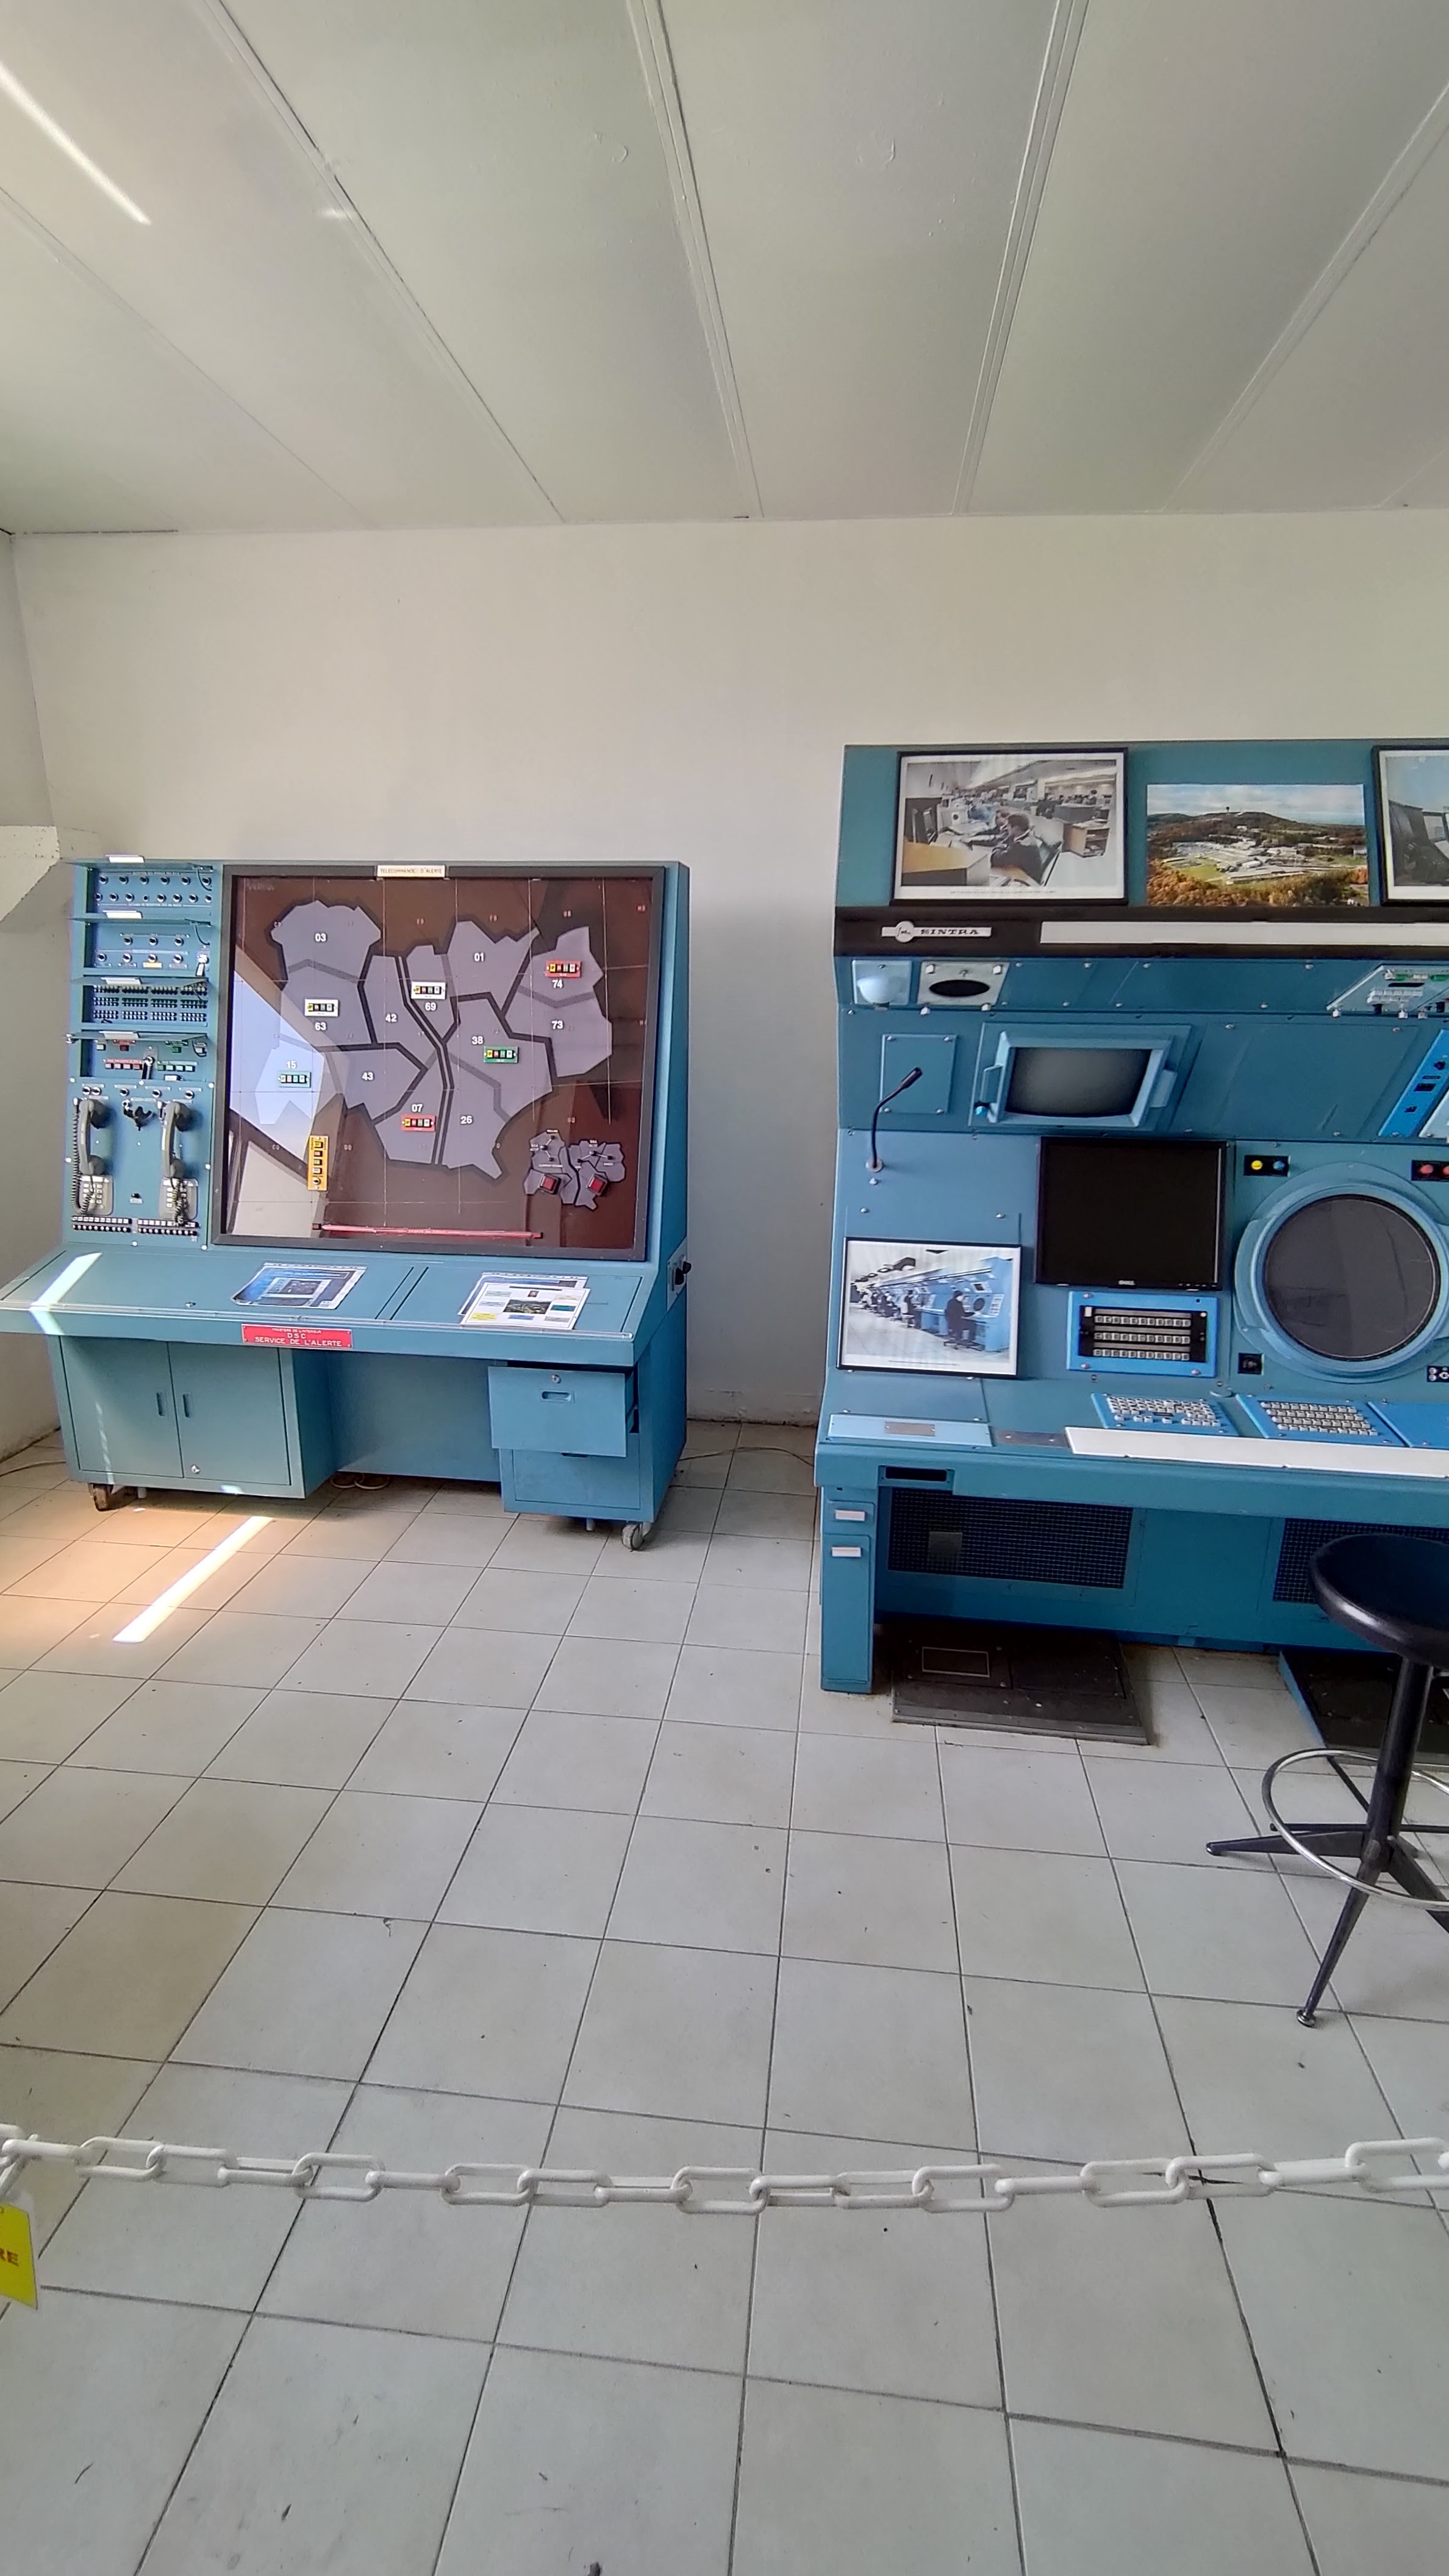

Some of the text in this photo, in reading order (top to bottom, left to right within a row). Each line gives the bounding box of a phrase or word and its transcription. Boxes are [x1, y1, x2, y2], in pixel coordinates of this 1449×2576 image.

[315, 933, 326, 942] 03
[474, 953, 485, 962] 01
[552, 979, 564, 989] 74
[425, 1002, 437, 1011] 69
[385, 1014, 397, 1022] 42
[315, 1022, 326, 1031] 63
[551, 1020, 564, 1029] 73
[471, 1036, 484, 1045] 38
[286, 1061, 296, 1069] 15
[362, 1072, 374, 1081] 43
[412, 1104, 423, 1112] 07
[460, 1115, 473, 1125] 26
